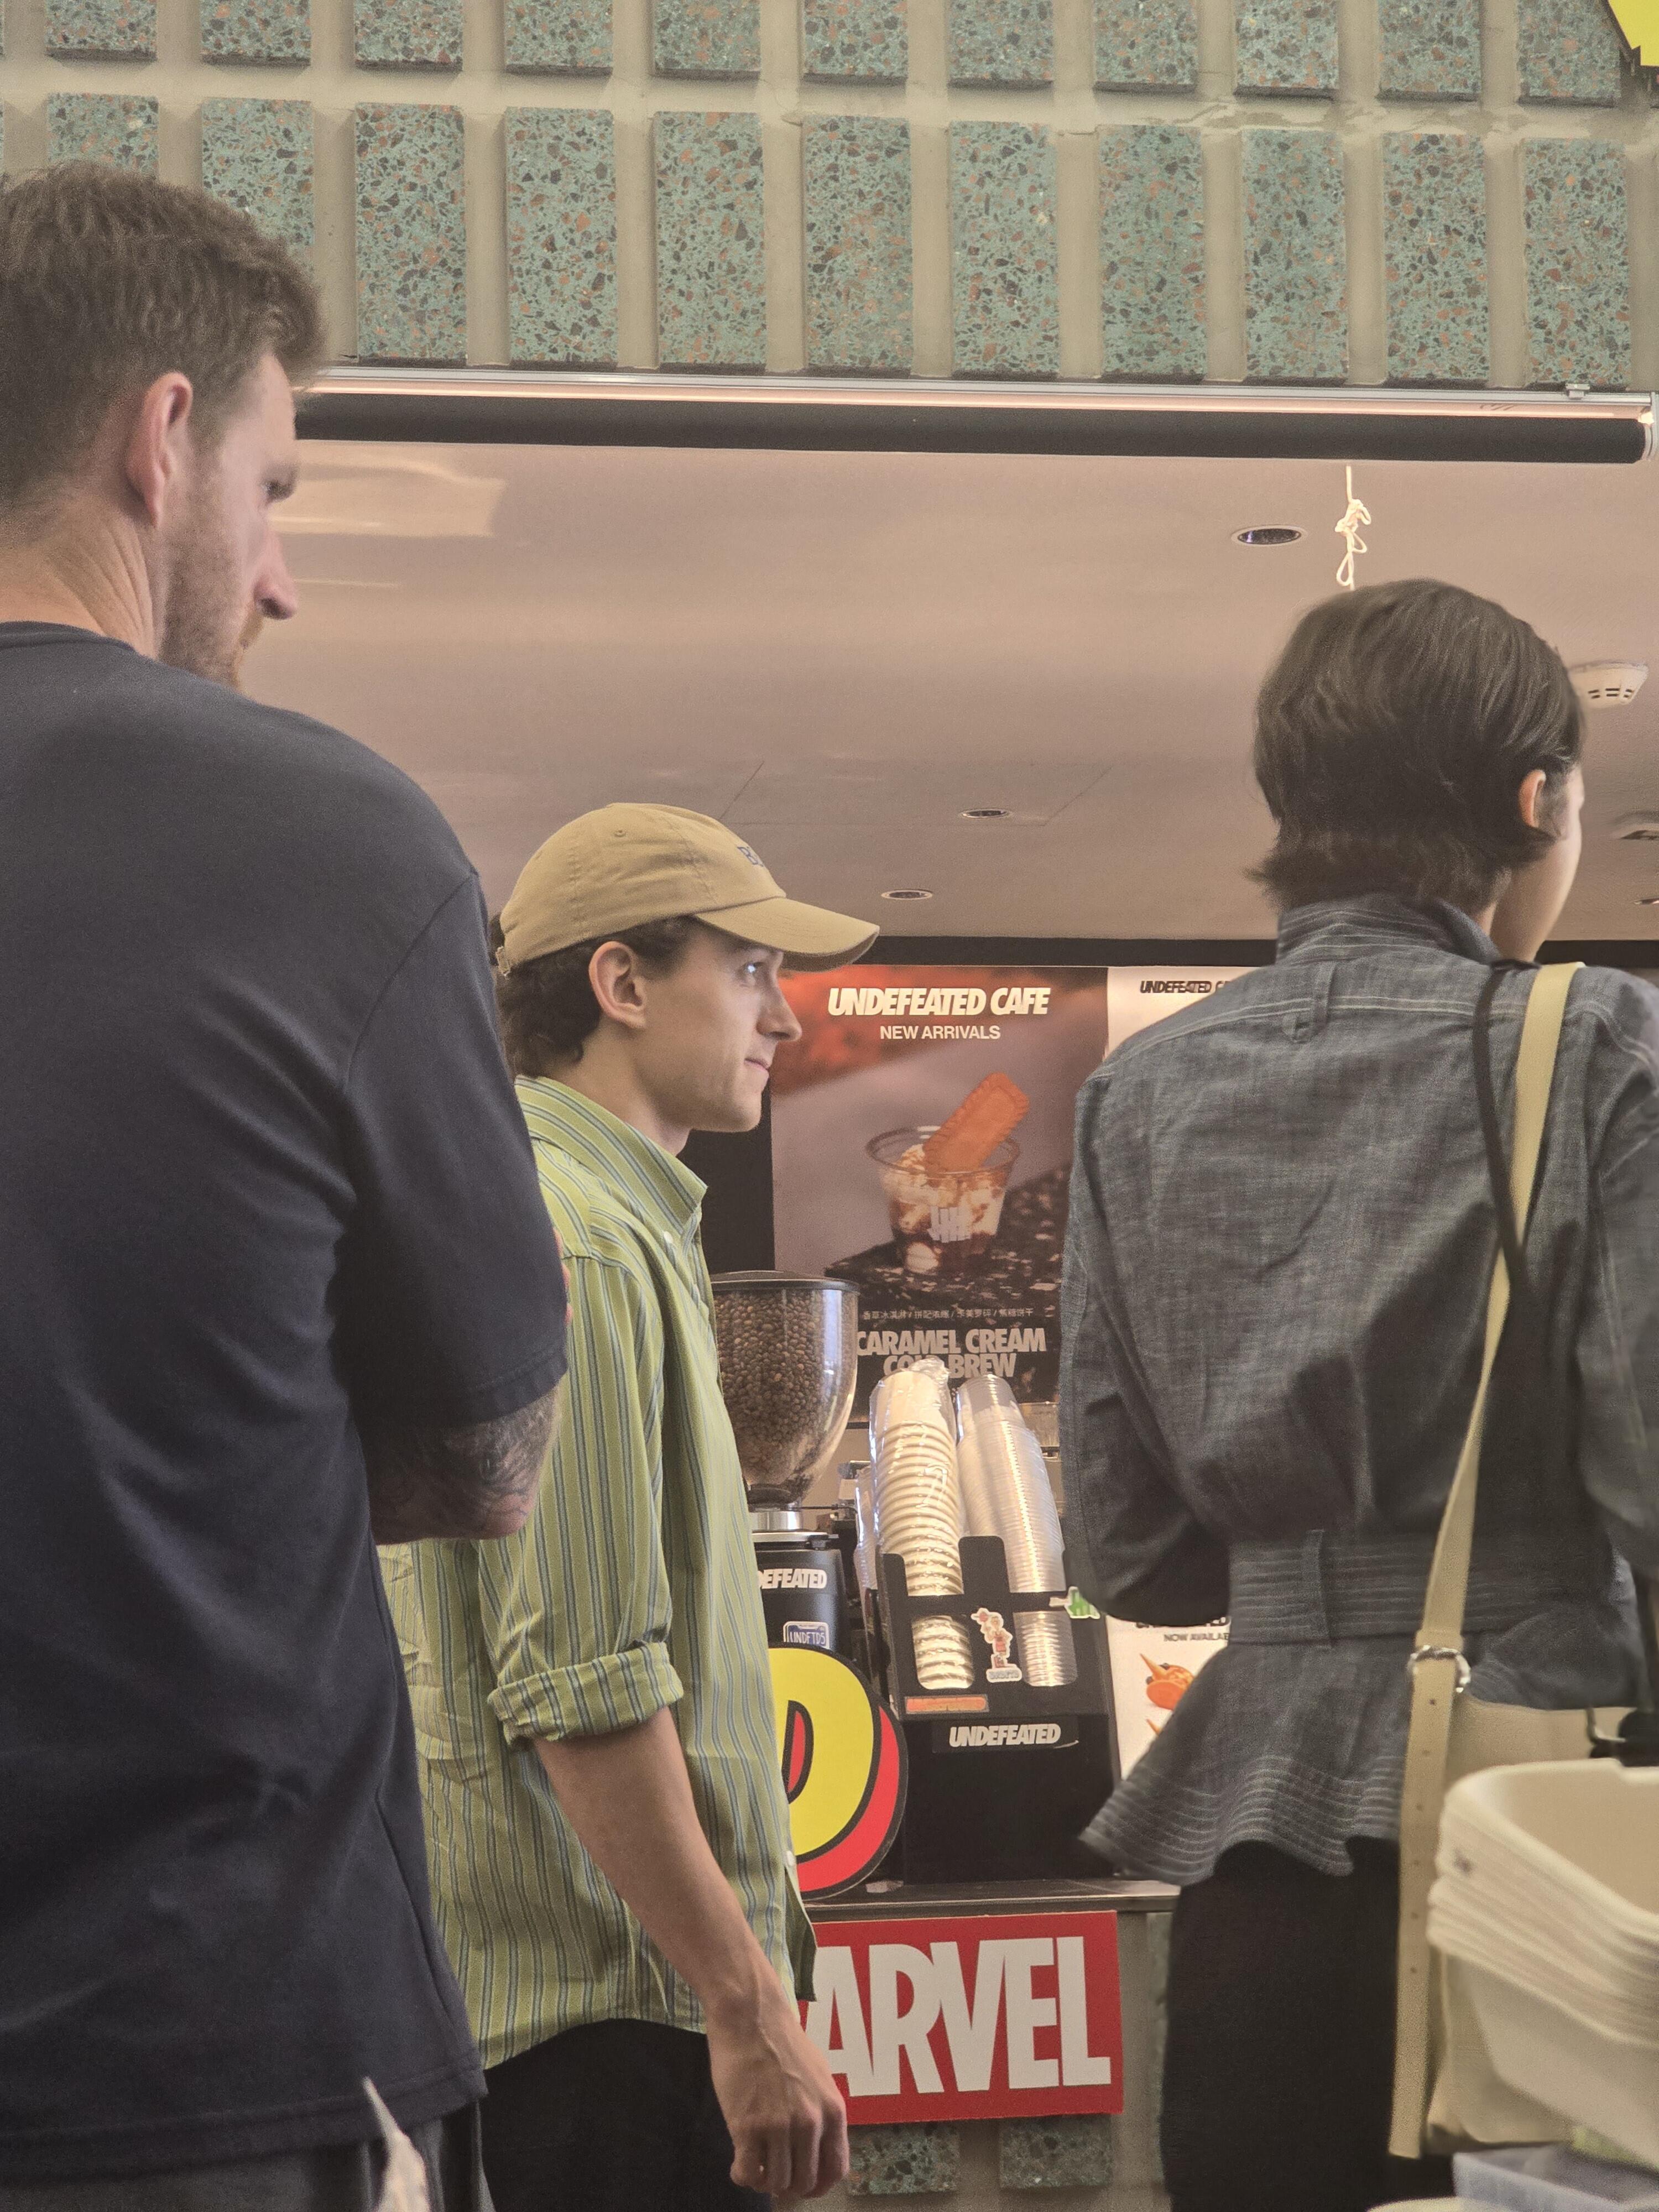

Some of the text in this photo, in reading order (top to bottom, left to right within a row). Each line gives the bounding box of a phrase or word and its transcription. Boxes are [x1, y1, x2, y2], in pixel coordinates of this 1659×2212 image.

[1140, 980, 1212, 994] UNDEFEATED
[828, 987, 1051, 1016] UNDEFEATED CAFE
[880, 1025, 1001, 1040] NEW ARRIVALS
[857, 1328, 1046, 1355] CARAMEL CREAM
[883, 1353, 1016, 1379] CO BREW
[949, 1723, 1061, 1747] UNDEFEATED
[805, 1936, 1112, 2097] ARVEL
